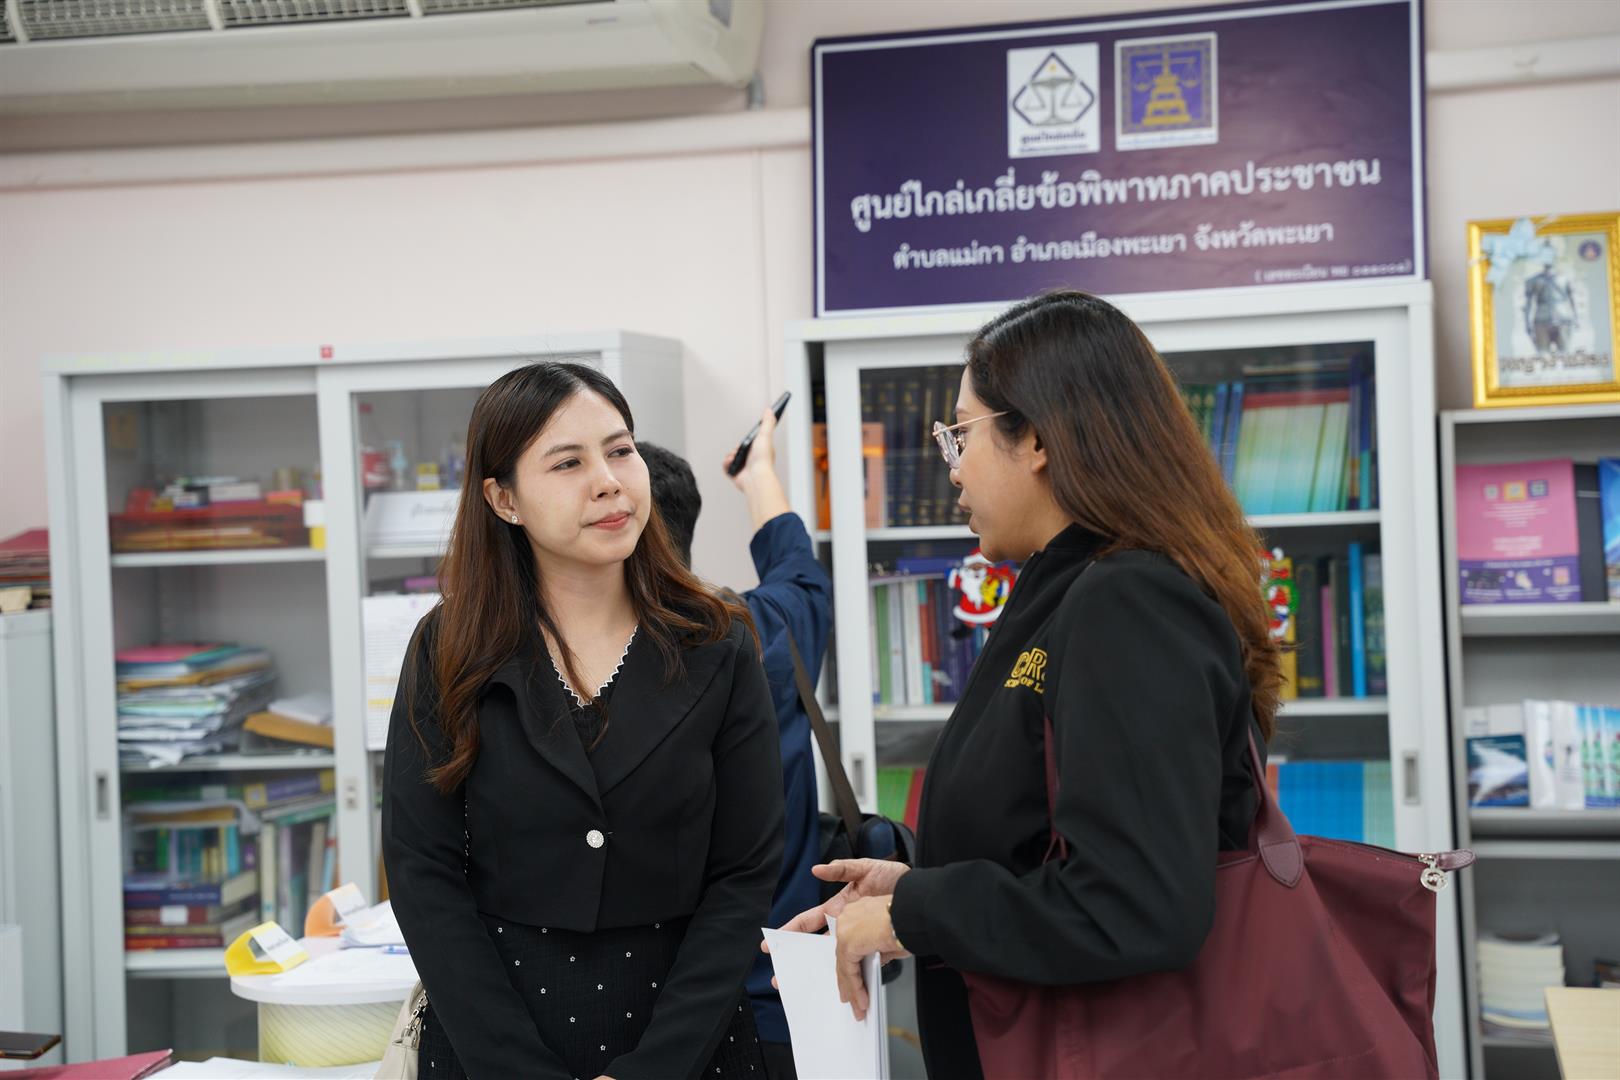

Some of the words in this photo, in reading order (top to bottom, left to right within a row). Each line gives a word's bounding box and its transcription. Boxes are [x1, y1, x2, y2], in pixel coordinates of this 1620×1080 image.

[851, 158, 1381, 232] ศูนย์ไกล่เกลี่ยข้อพิพาทภาคประชาชน
[893, 239, 1004, 270] ตำบลแม่กา
[1011, 231, 1186, 263] อำเภอเมืองพะเยา
[1194, 220, 1334, 251] จังหวัดพะเยา
